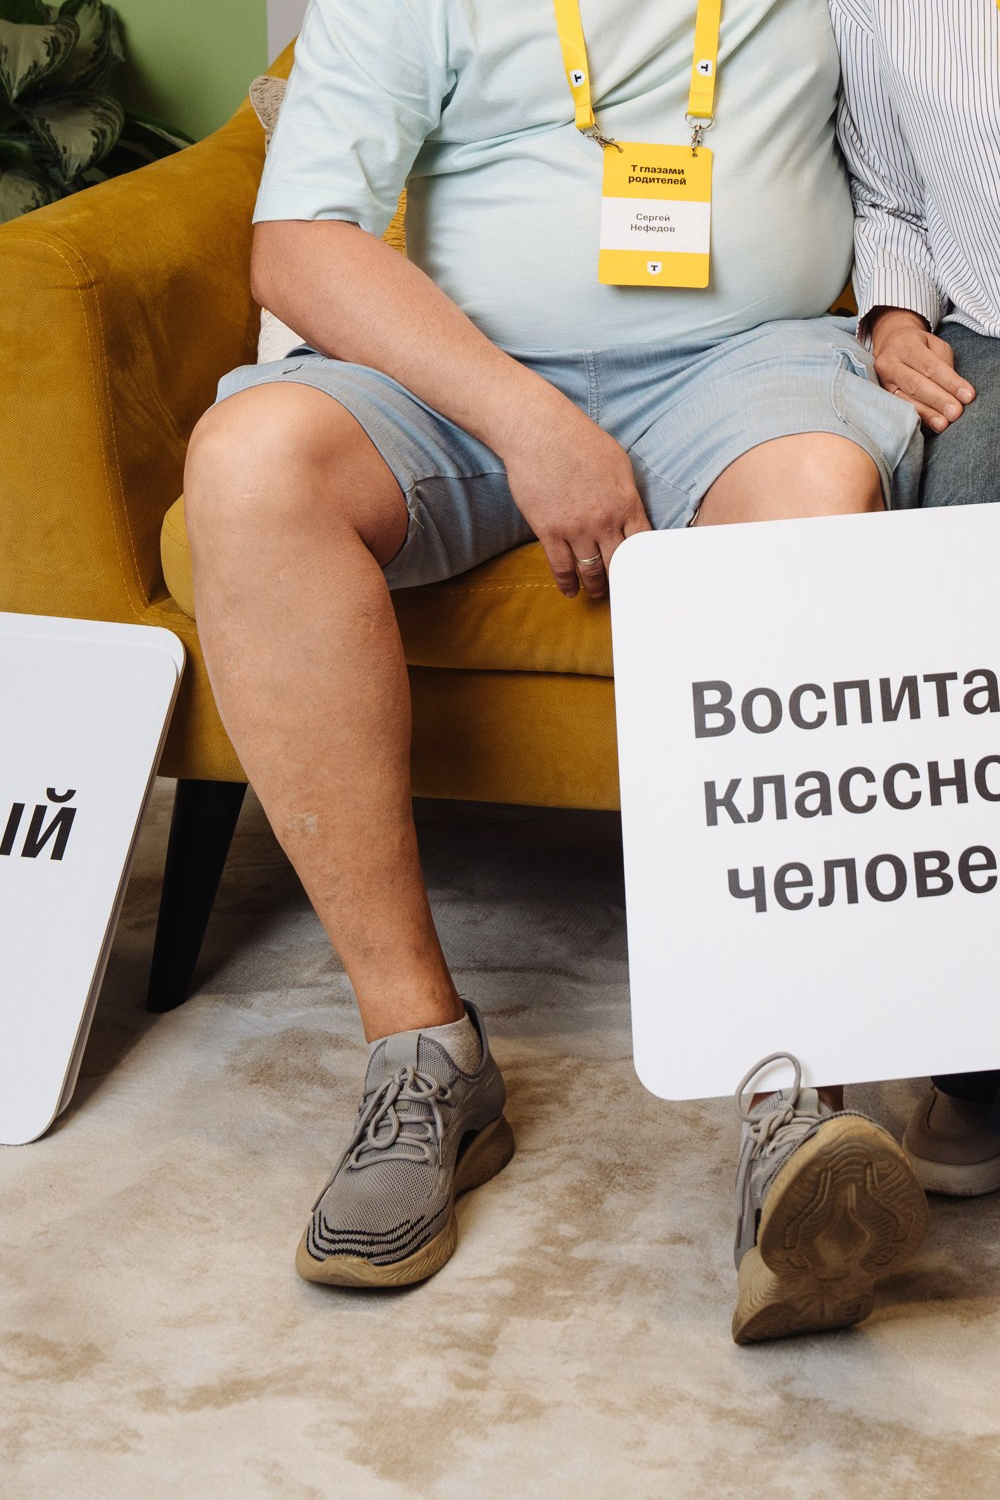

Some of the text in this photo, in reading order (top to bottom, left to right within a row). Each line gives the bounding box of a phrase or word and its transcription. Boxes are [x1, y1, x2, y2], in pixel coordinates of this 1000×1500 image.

[631, 164, 685, 175] Т глазами
[628, 175, 687, 185] родителей
[635, 213, 671, 223] Сергей
[630, 223, 676, 233] Нефедов
